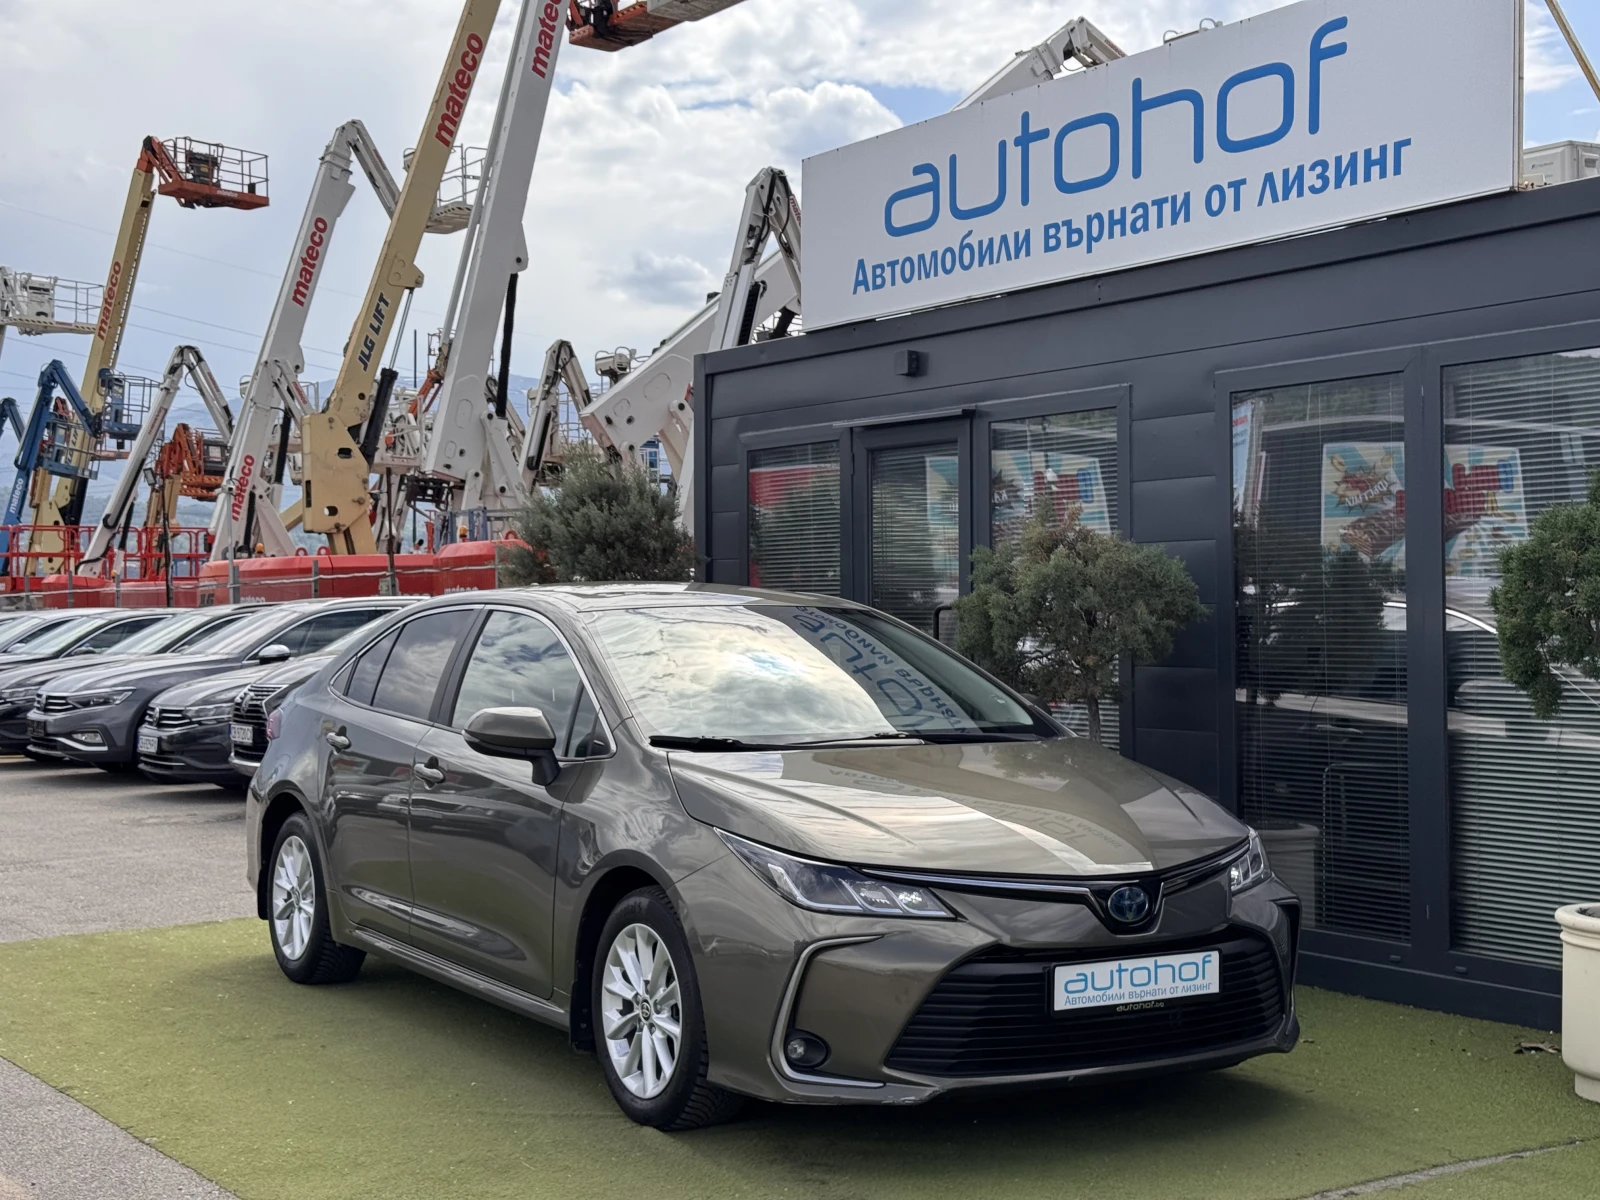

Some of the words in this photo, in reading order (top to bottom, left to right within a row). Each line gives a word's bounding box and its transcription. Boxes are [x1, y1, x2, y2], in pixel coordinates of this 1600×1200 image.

[531, 0, 562, 79] mate
[435, 33, 483, 148] mateco
[884, 16, 1348, 237] autohof
[790, 197, 801, 228] mate
[852, 228, 1031, 295] Автомобили
[1043, 191, 1191, 254] върнати
[1204, 178, 1247, 217] от
[1257, 138, 1412, 207] лизинг
[97, 261, 121, 340] mateco
[292, 217, 328, 307] mateco
[358, 334, 375, 372] JLG
[369, 292, 389, 336] LIFT
[9, 478, 24, 514] mateco
[231, 454, 255, 522] mateco
[1064, 954, 1212, 994] autohof
[1064, 991, 1125, 1006] Автомобили
[1128, 988, 1166, 1000] върнати
[1169, 985, 1179, 994] от
[1181, 982, 1212, 993] лизинг
[1116, 1001, 1165, 1012] autohof.bg
